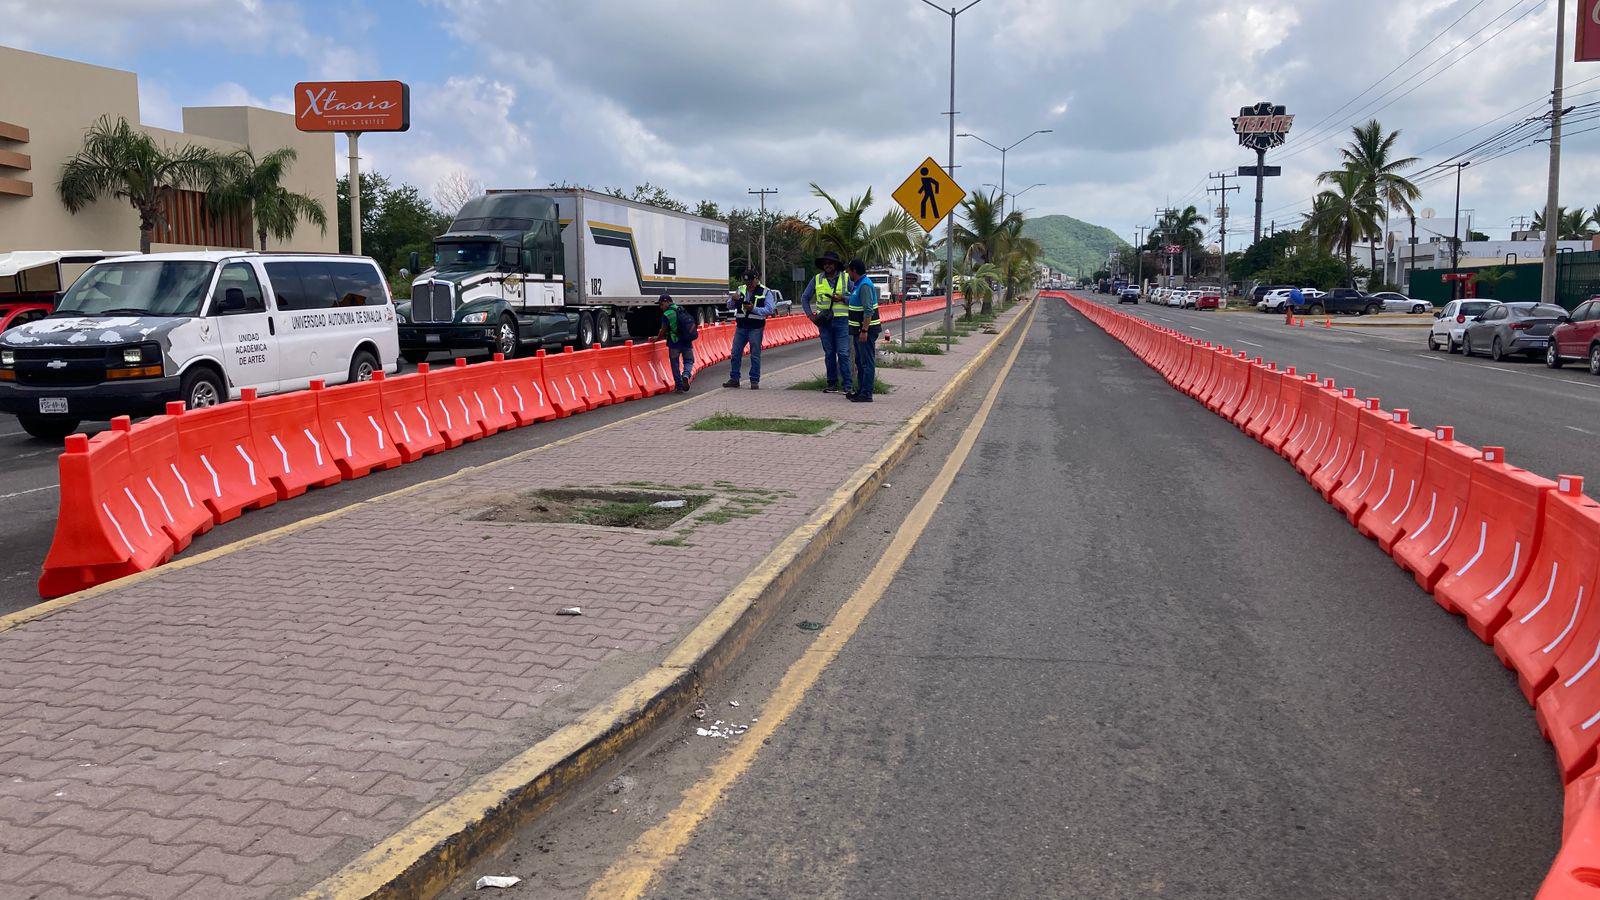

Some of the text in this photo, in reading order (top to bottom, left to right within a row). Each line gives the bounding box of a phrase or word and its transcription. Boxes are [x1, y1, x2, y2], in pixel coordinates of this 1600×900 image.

[301, 87, 397, 119] Xtasis
[1235, 115, 1292, 133] TECATE
[590, 278, 602, 296] 182
[291, 310, 382, 329] UNIVERSIDAD AUTONOMA DE SINALOA
[238, 332, 260, 343] UNIDAD
[235, 343, 268, 354] ACADEMICA
[239, 354, 266, 366] DE ARTES
